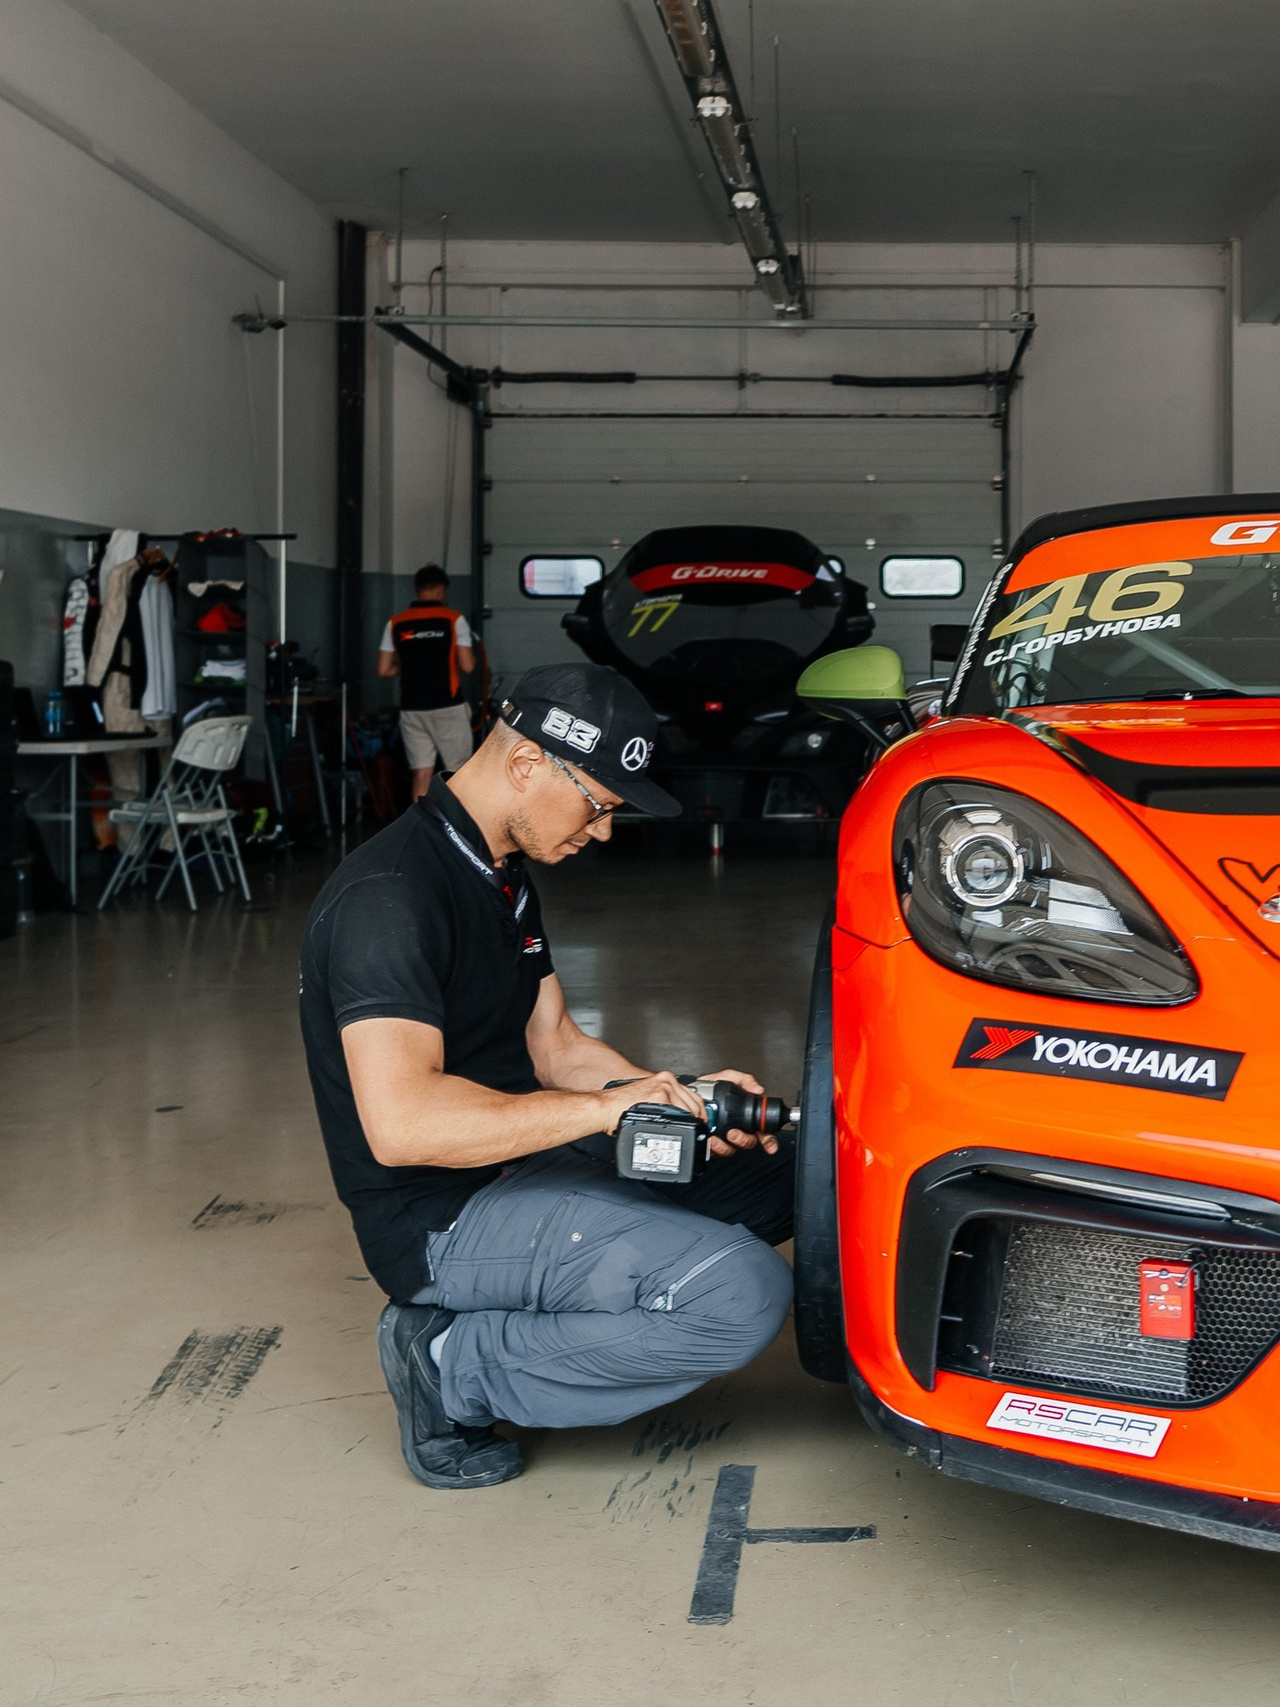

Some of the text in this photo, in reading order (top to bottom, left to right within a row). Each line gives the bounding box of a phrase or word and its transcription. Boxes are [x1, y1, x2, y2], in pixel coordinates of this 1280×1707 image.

[671, 566, 769, 580] G-DRIVE
[628, 602, 681, 638] 77
[988, 561, 1194, 642] 46
[444, 822, 494, 876] TORSPORT
[1032, 1035, 1217, 1087] YOKOHAMA
[997, 1415, 1150, 1448] MOTORSPORT
